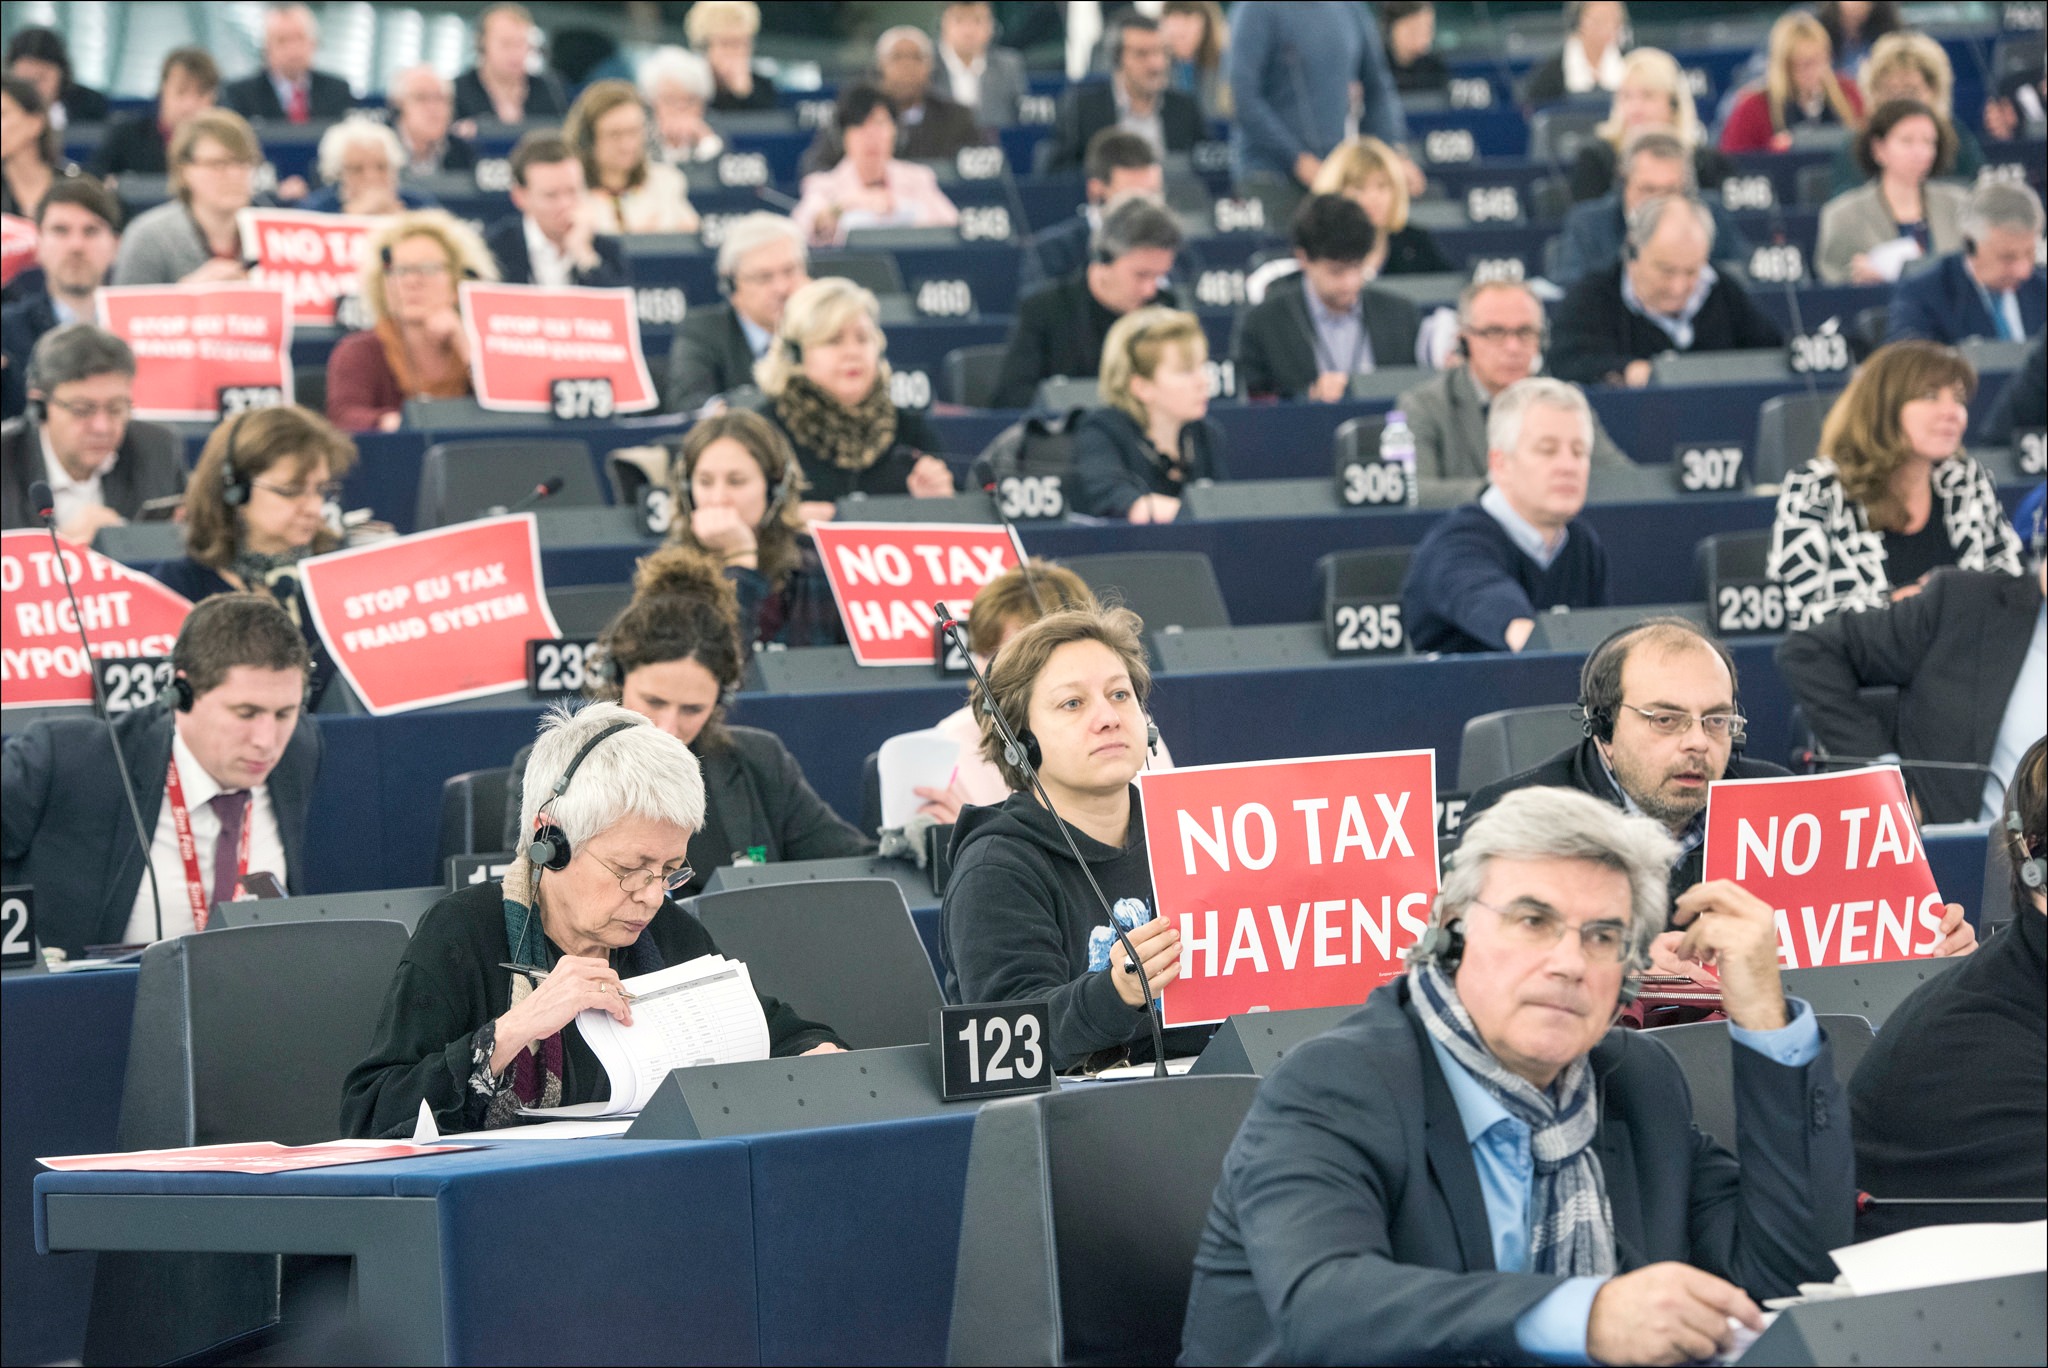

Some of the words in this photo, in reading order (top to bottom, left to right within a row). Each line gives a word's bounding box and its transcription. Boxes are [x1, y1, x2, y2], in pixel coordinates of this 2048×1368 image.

[554, 380, 613, 419] 379
[1344, 463, 1404, 505] 306
[1682, 448, 1743, 490] 307
[1001, 476, 1063, 518] 305
[28, 549, 83, 588] TO
[835, 543, 912, 587] NO
[913, 544, 1005, 586] TAX
[343, 584, 411, 620] STOP
[413, 576, 450, 604] EU
[453, 562, 507, 594] TAX
[1719, 584, 1784, 630] 236
[15, 591, 132, 638] RIGHT
[342, 617, 428, 653] FRAUD
[429, 592, 529, 635] SYSTEM
[1336, 604, 1402, 650] 235
[1176, 801, 1278, 876] NO
[1293, 791, 1415, 866] TAX
[1736, 812, 1822, 881] NO
[1839, 801, 1927, 871] TAX
[1179, 891, 1427, 980] HAVENS
[958, 1013, 1043, 1083] 123
